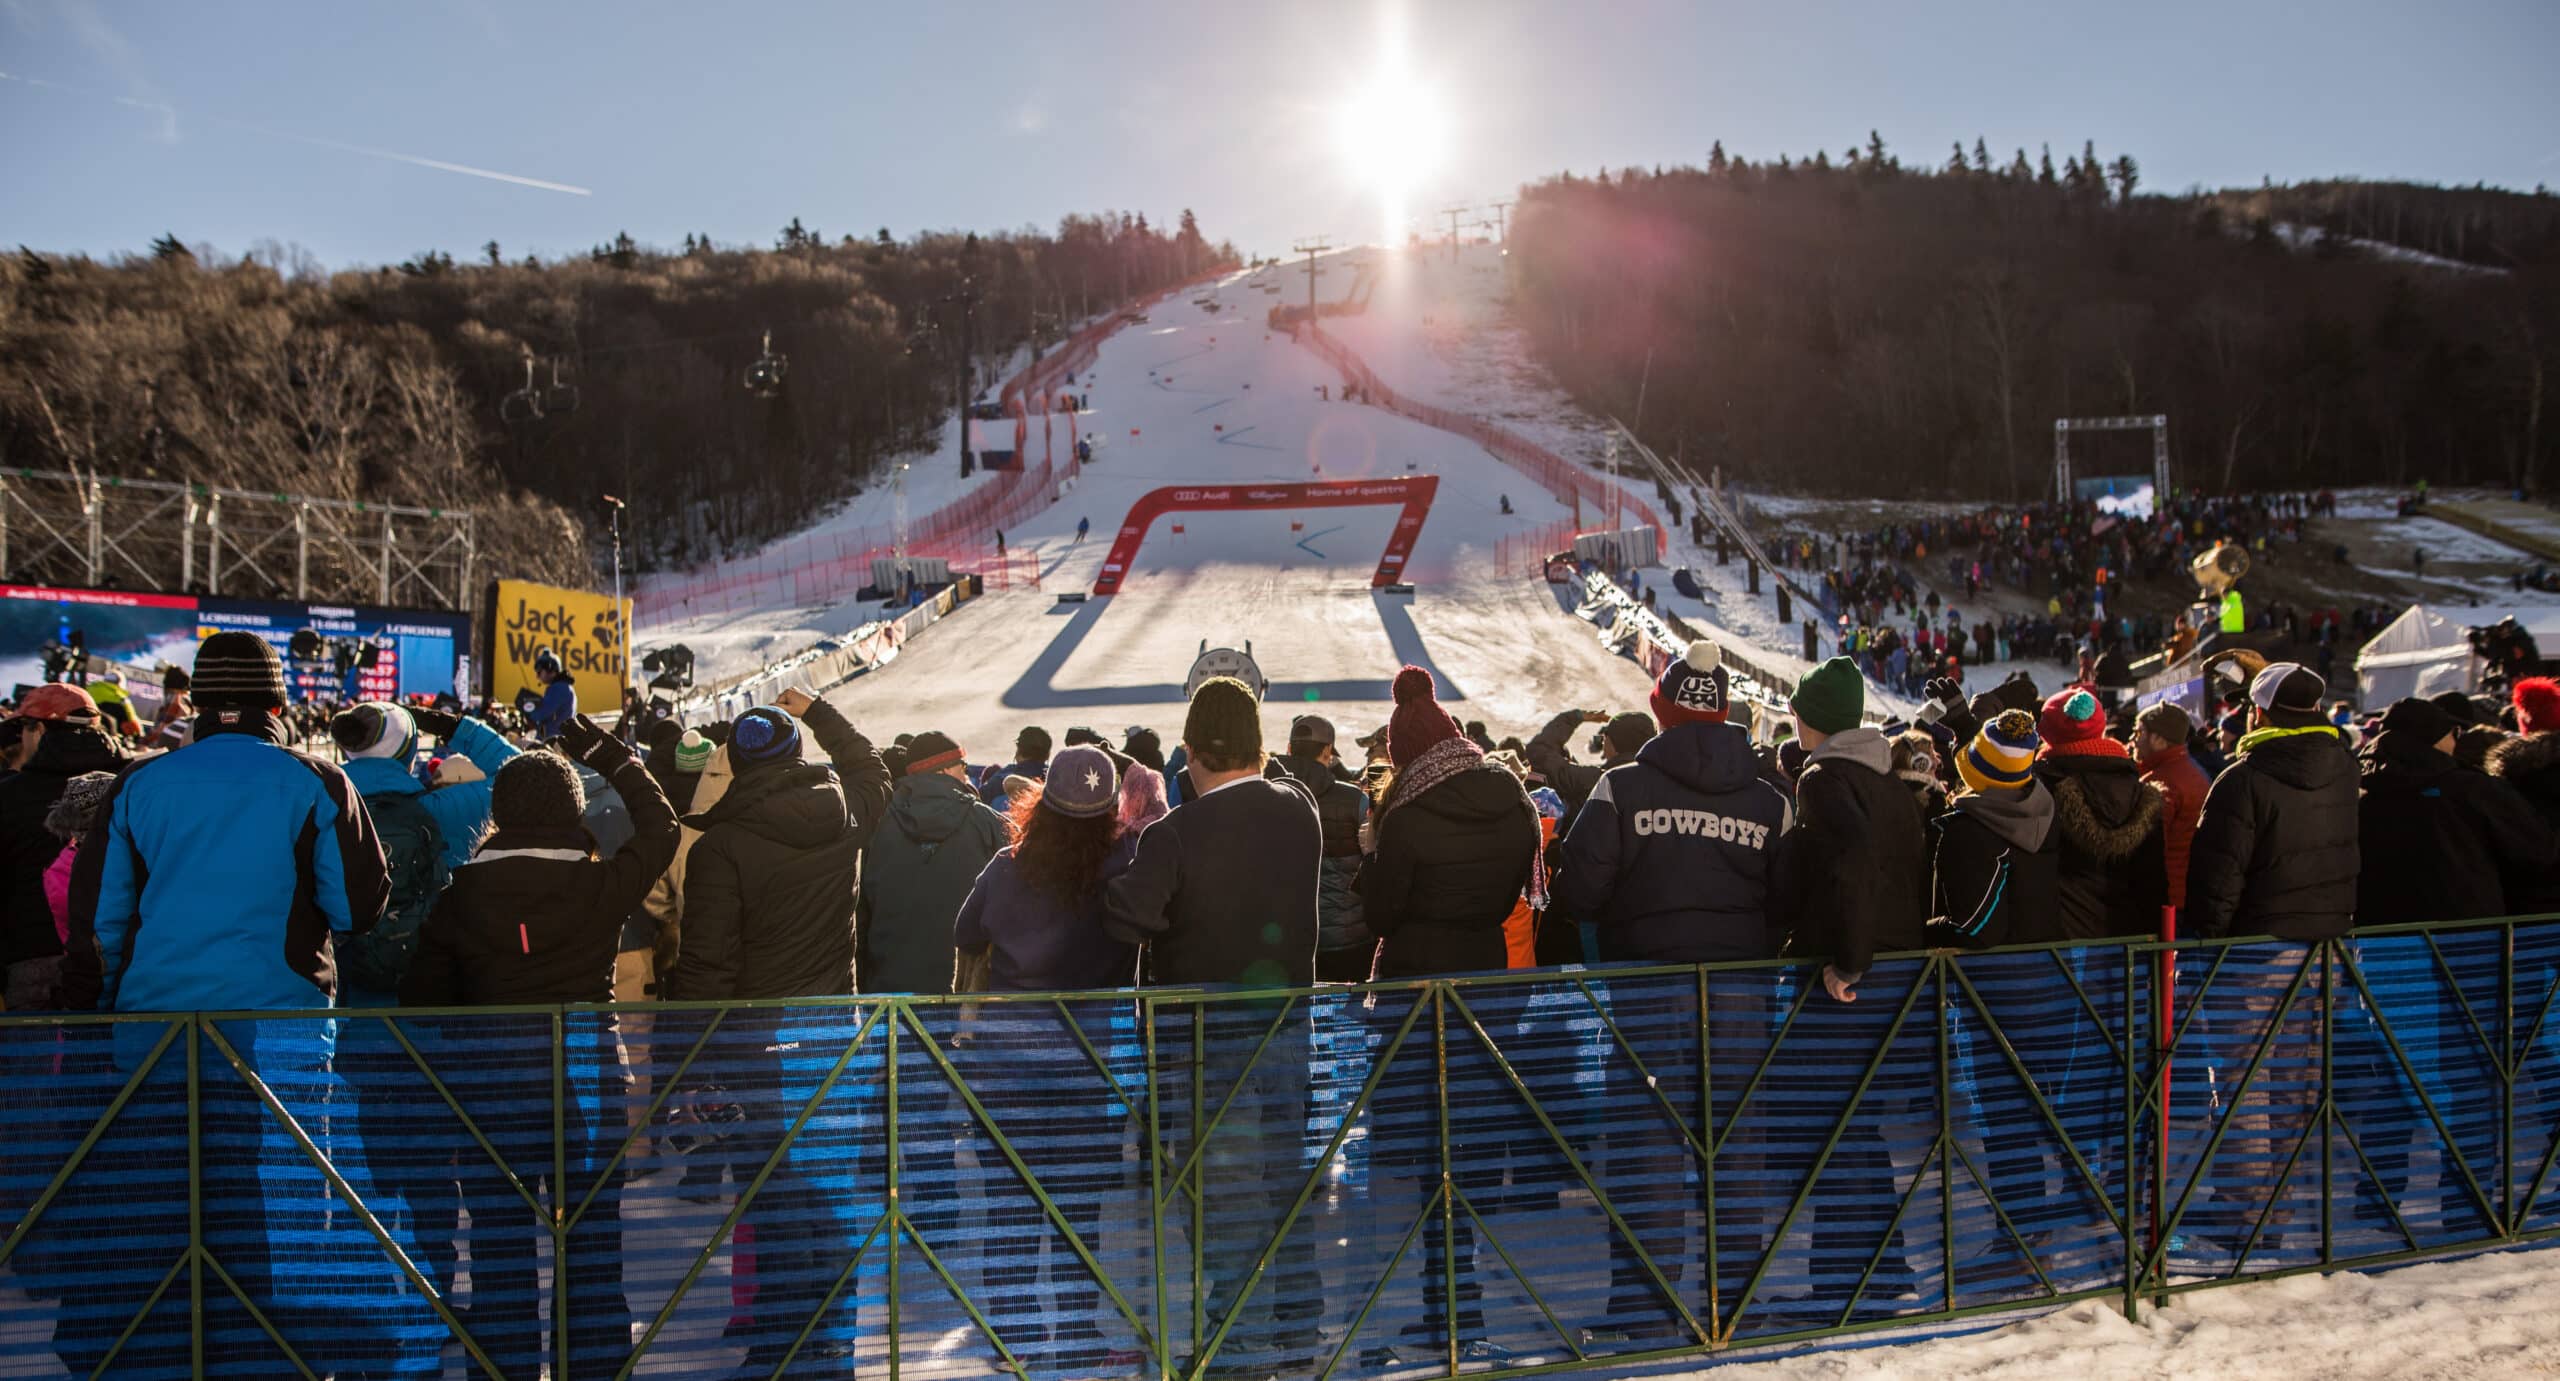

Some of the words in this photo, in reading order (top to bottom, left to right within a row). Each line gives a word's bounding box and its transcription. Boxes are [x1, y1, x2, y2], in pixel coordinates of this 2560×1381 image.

[1202, 491, 1230, 500] Audi
[1306, 487, 1342, 497] Home
[1344, 486, 1358, 496] of
[1360, 483, 1407, 497] quattro
[199, 611, 271, 626] LONGINES
[506, 599, 575, 637] Jack
[386, 623, 452, 637] LONGINES
[1683, 678, 1715, 693] US
[1634, 808, 1770, 850] COWBOYS
